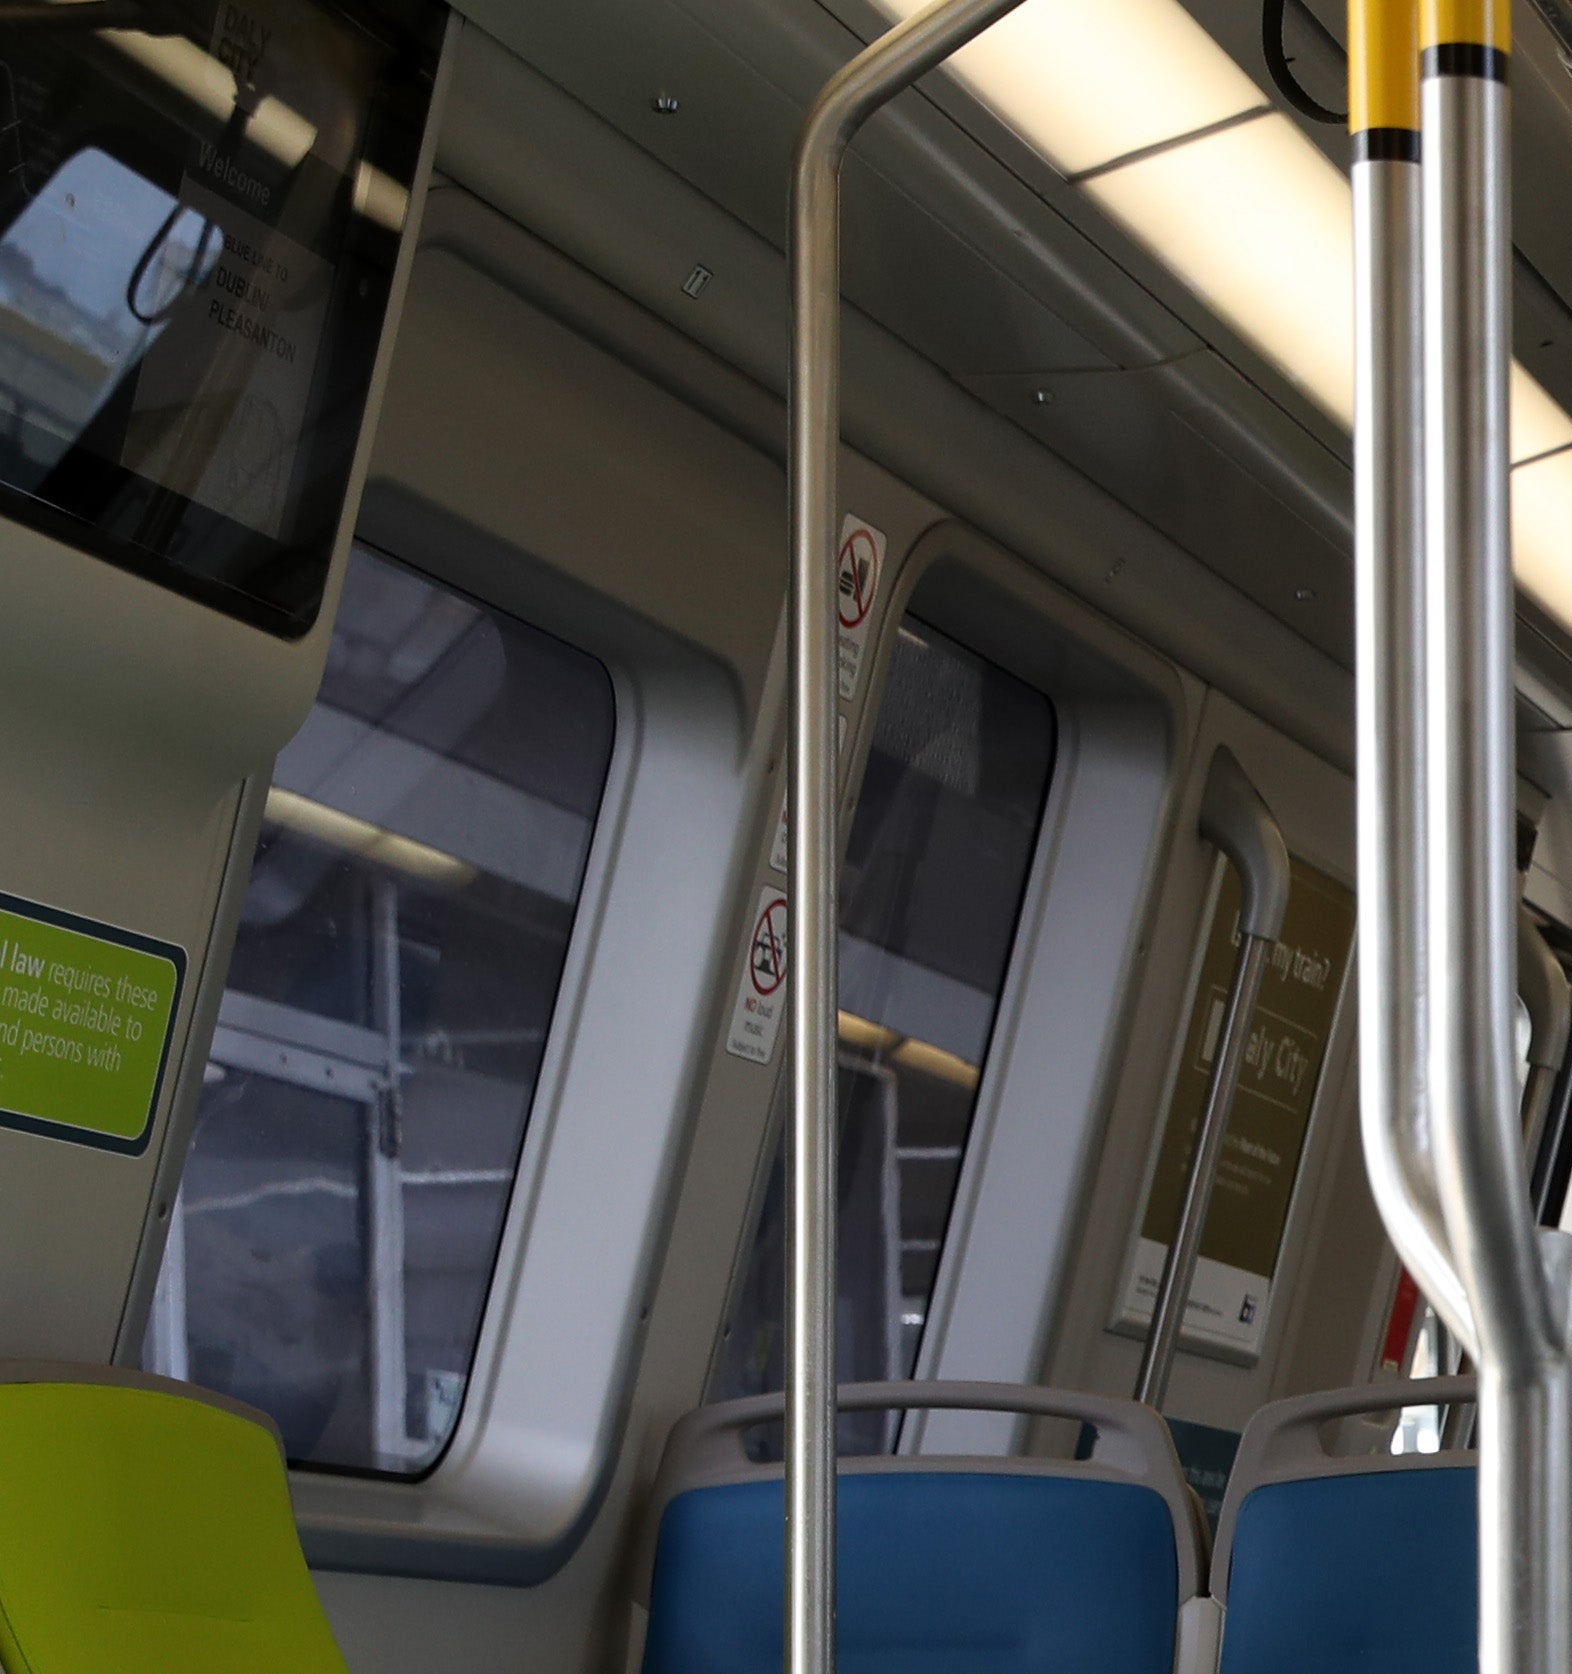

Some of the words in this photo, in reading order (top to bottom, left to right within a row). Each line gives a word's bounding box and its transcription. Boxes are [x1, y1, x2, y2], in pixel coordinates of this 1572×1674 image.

[199, 142, 271, 206] Welcome
[225, 234, 250, 262] BLUE
[276, 264, 289, 283] TO
[209, 299, 297, 363] PLEASANTON
[10, 943, 45, 979] law
[48, 964, 112, 998] requires
[116, 976, 158, 1012] these
[1292, 945, 1331, 992] train?
[2, 985, 49, 1017] made
[52, 999, 122, 1037] available
[125, 1015, 143, 1042] to
[20, 1028, 85, 1064] persons
[87, 1042, 122, 1073] with
[1244, 1024, 1275, 1081] aly
[1275, 1034, 1310, 1097] City
